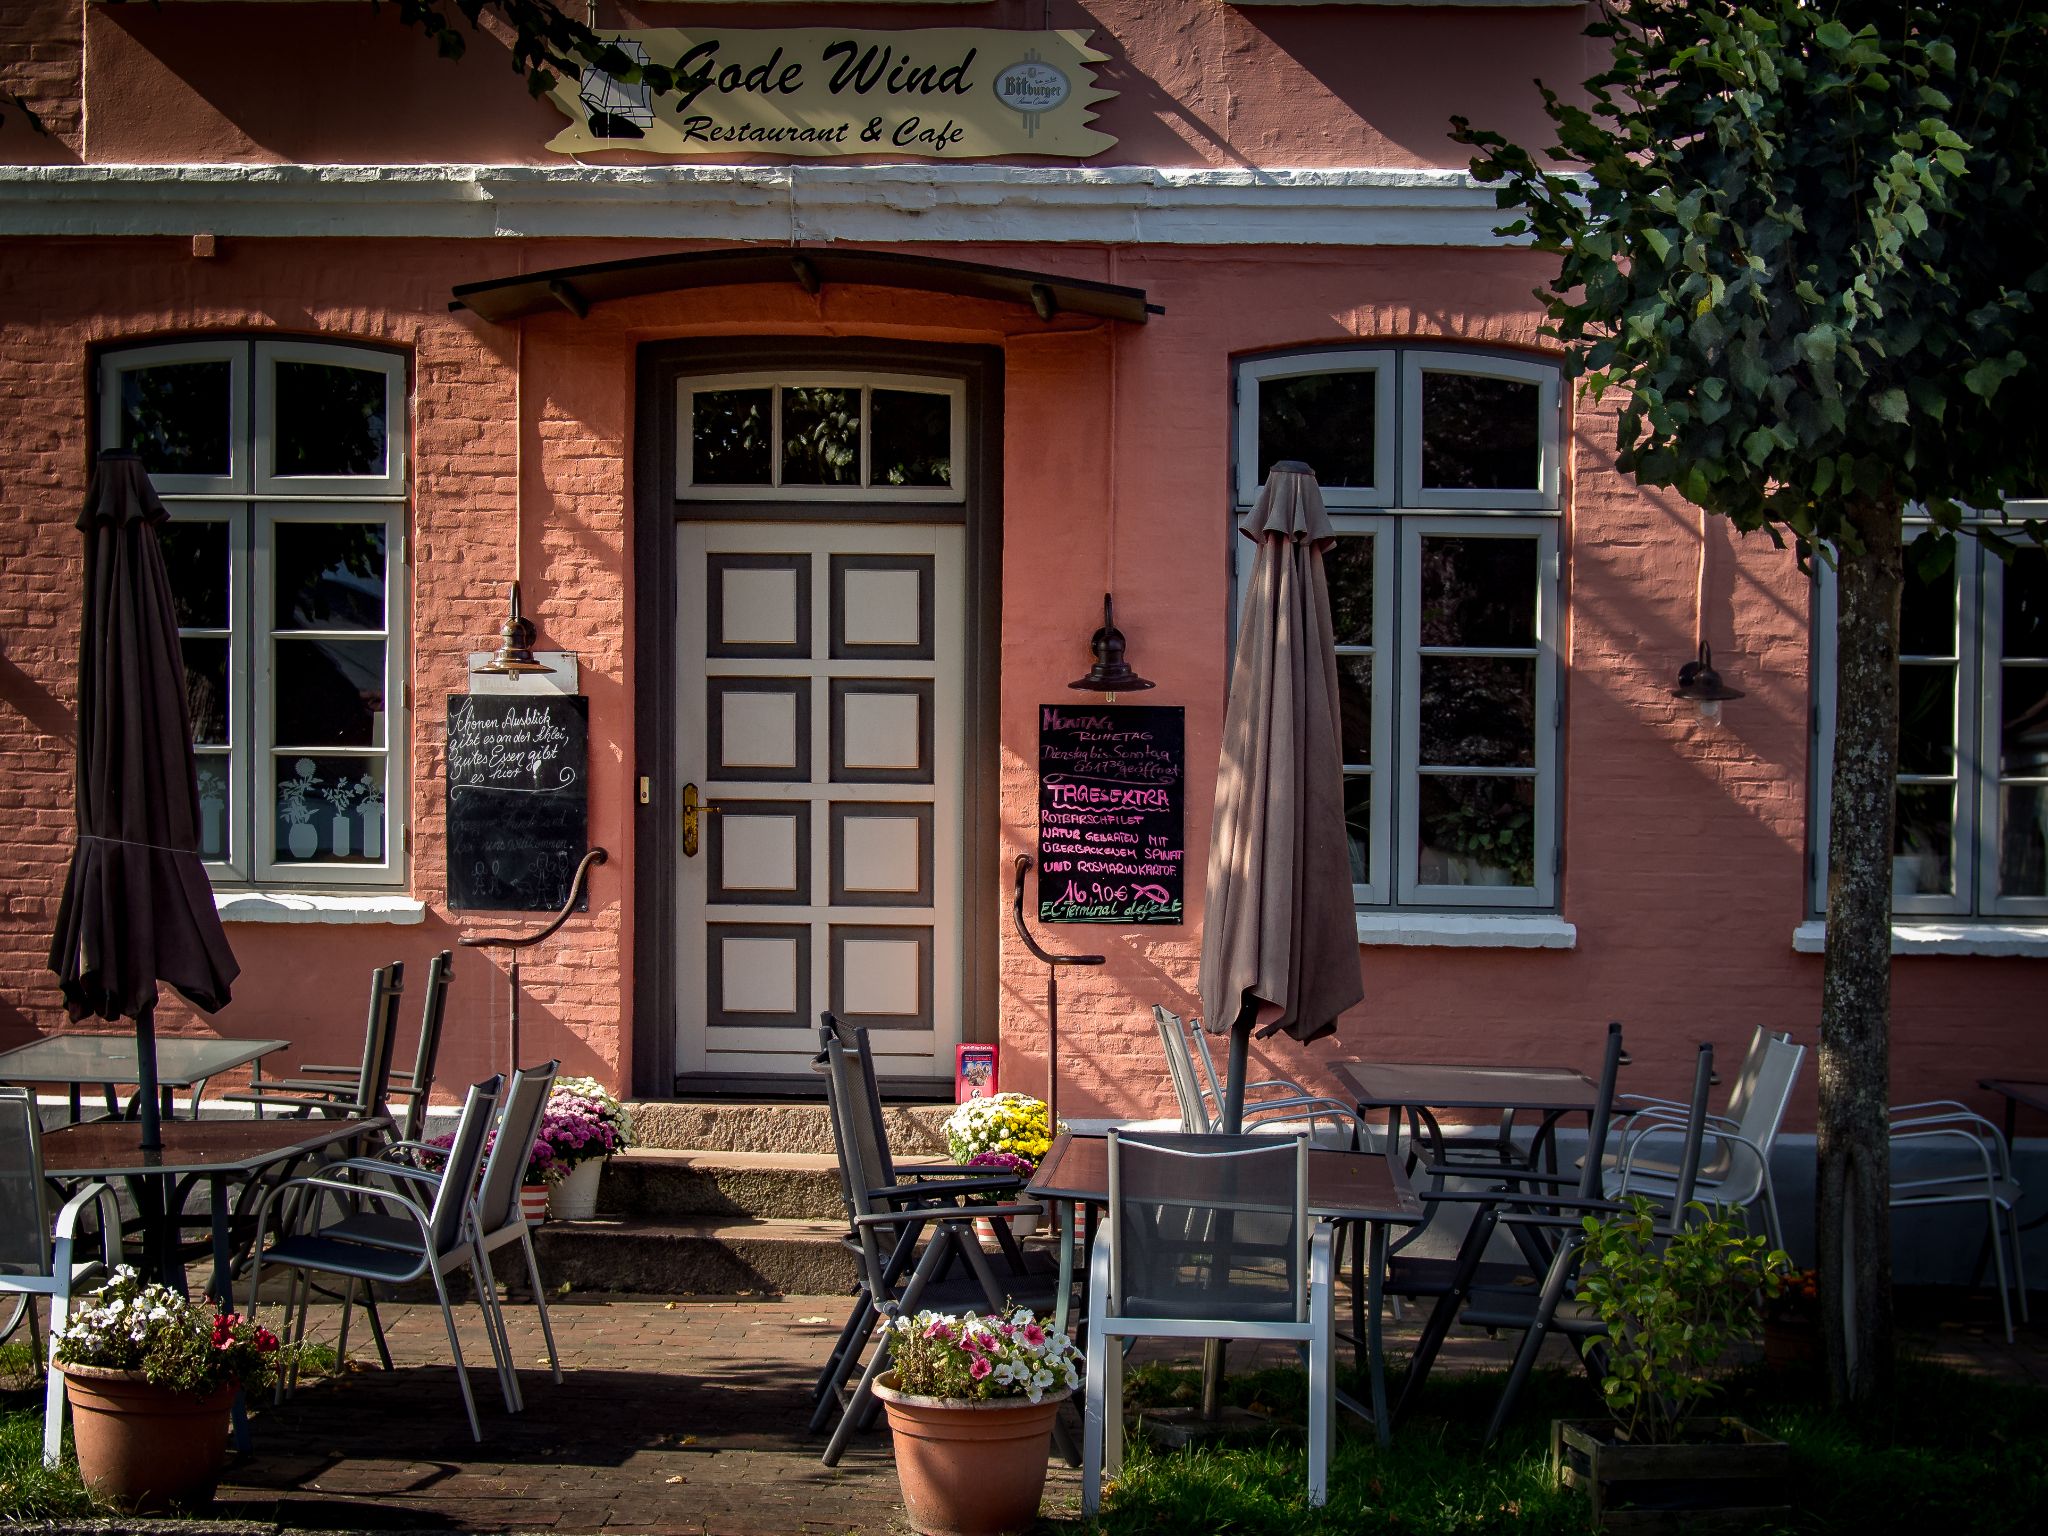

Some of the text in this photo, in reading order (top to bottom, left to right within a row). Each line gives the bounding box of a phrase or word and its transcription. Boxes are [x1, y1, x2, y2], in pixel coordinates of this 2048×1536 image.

[674, 40, 977, 113] Gode Wind
[1004, 75, 1061, 98] Bitburger
[682, 116, 964, 151] Restaurant & Cafe
[502, 707, 551, 728] Ausblick
[449, 733, 480, 760] gibt
[484, 735, 495, 745] es
[496, 734, 512, 743] an
[513, 730, 530, 743] der
[1068, 731, 1154, 742] RUHETAG
[450, 744, 558, 780] gutes Essen gibt
[1041, 744, 1171, 762] Dienstag bis Sonntag
[470, 773, 484, 784] es
[489, 763, 522, 779] hier
[1116, 761, 1182, 778] geöffnet
[1047, 784, 1170, 806] TAGESEXTRA
[1042, 809, 1145, 825] ROTBARSCHFILET
[1042, 827, 1169, 847] NATUR GEBRATEN MIT
[1042, 842, 1184, 861] ÜBERBACKENEM SPINAT
[1043, 861, 1072, 873] UND
[1123, 899, 1183, 921] defekt
